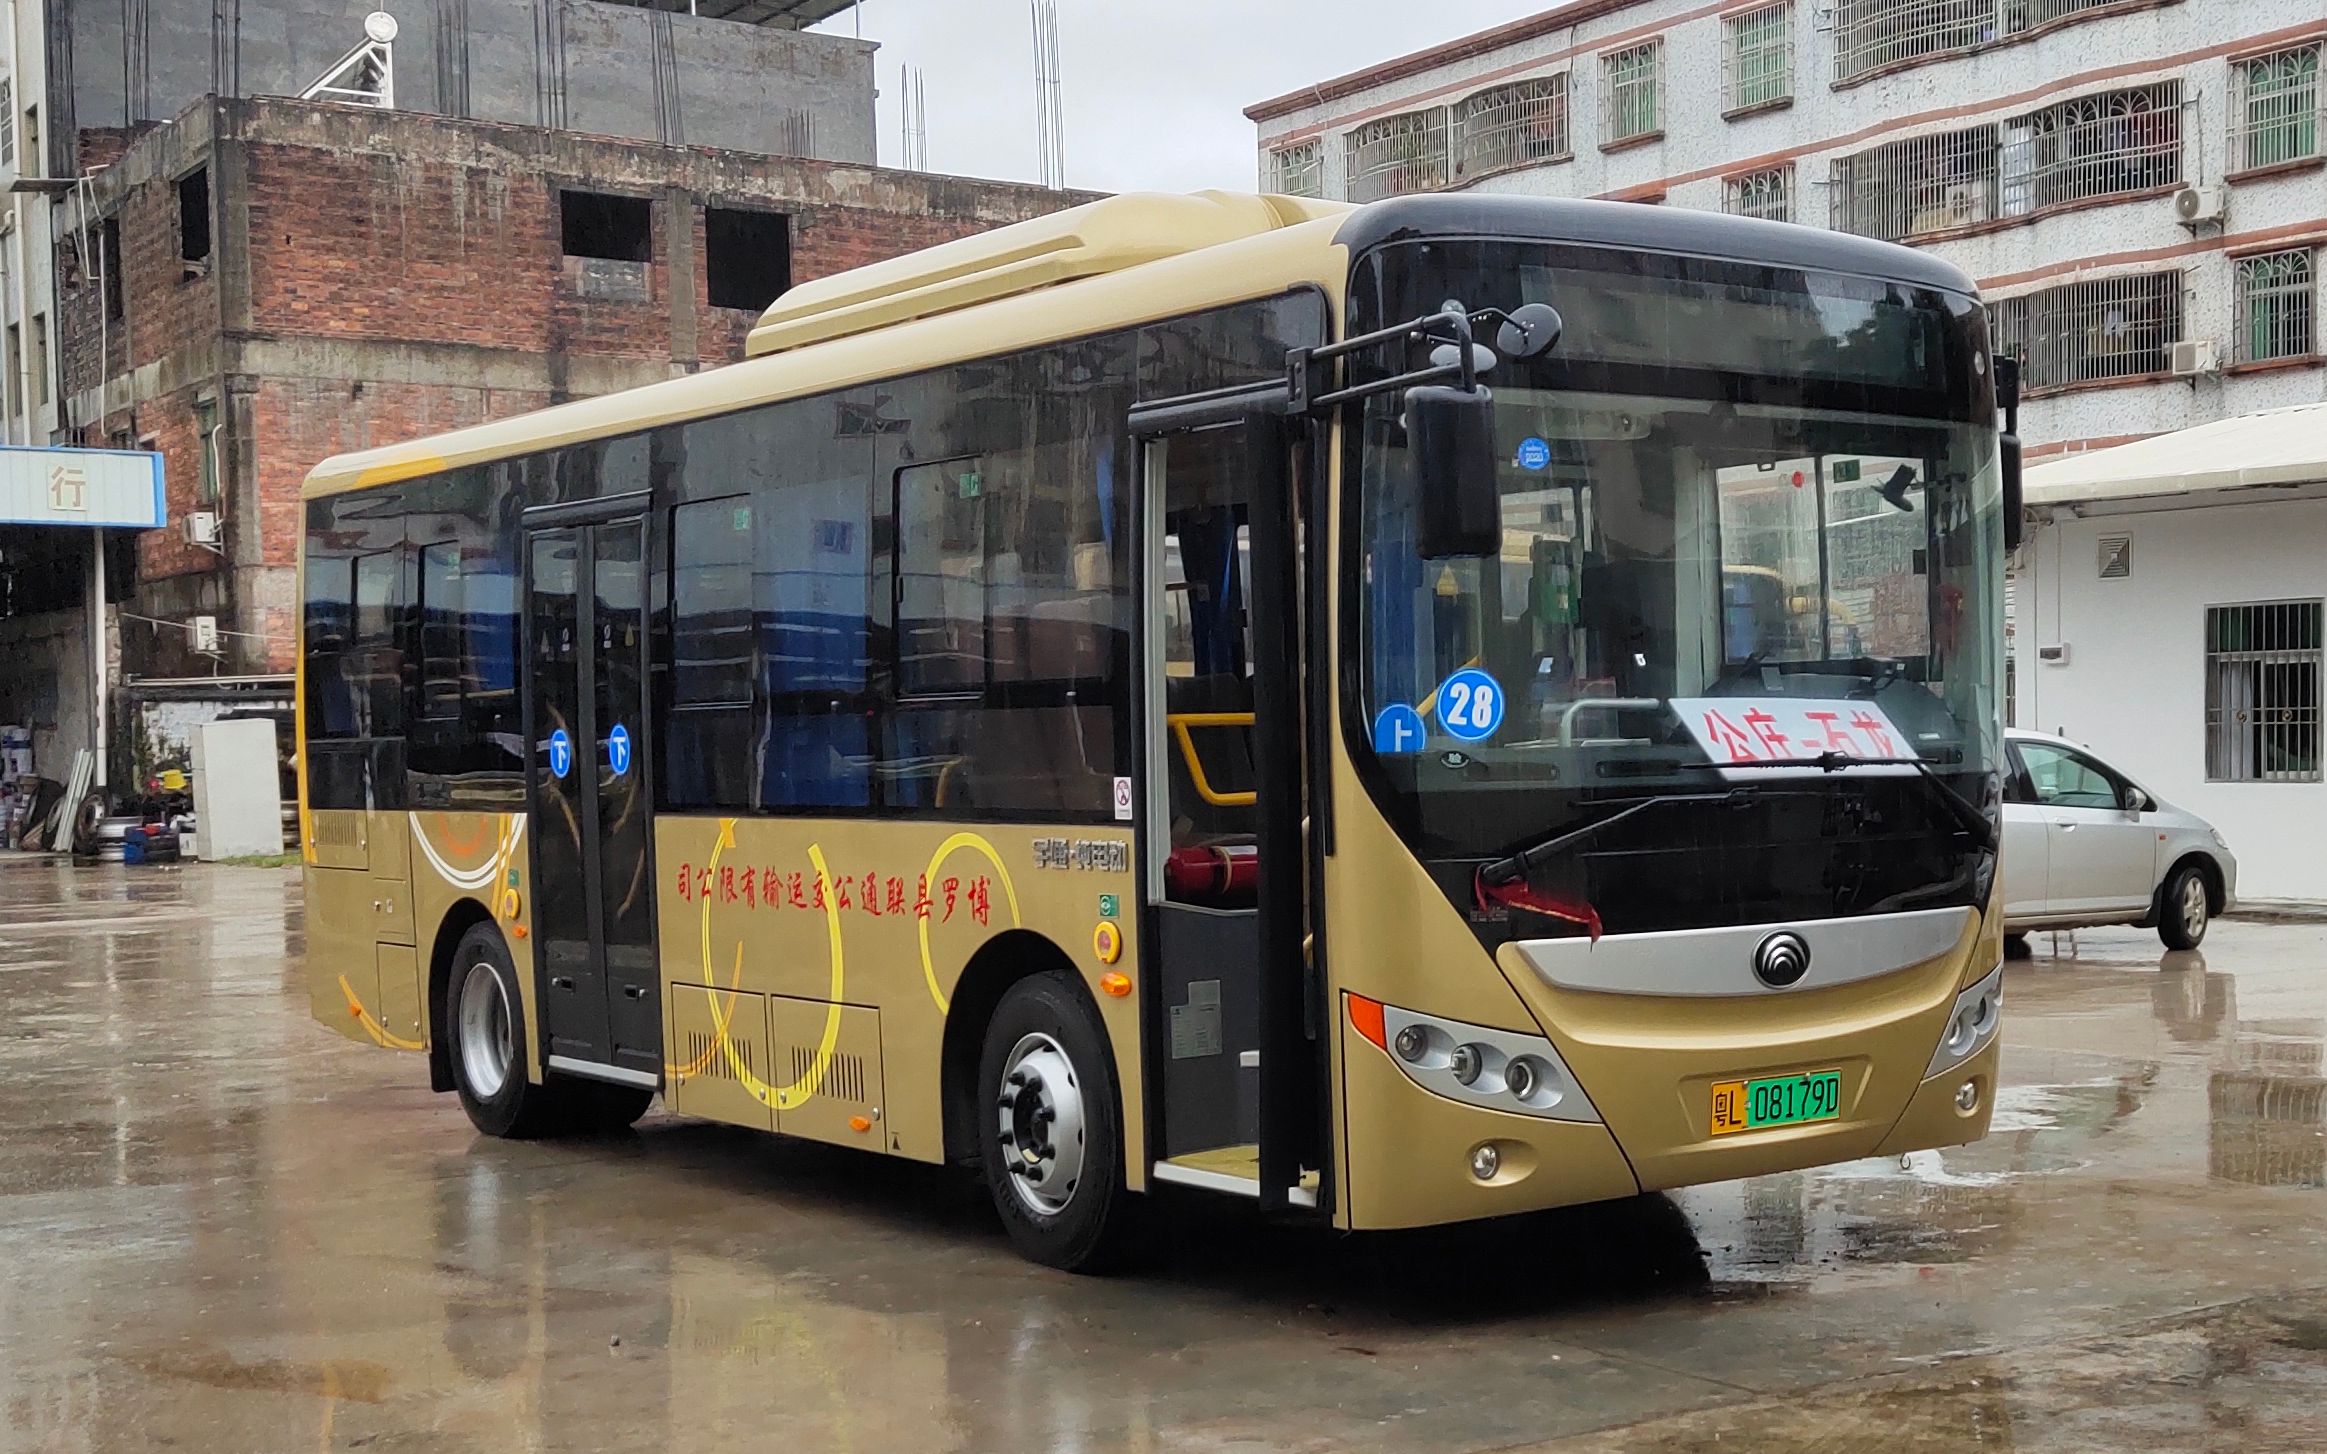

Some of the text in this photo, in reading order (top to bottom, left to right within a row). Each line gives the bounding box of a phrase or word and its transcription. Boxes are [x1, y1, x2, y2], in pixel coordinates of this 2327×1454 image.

[51, 466, 86, 507] 行
[1447, 682, 1493, 728] 28
[554, 741, 566, 769] 下
[613, 736, 626, 766] 下
